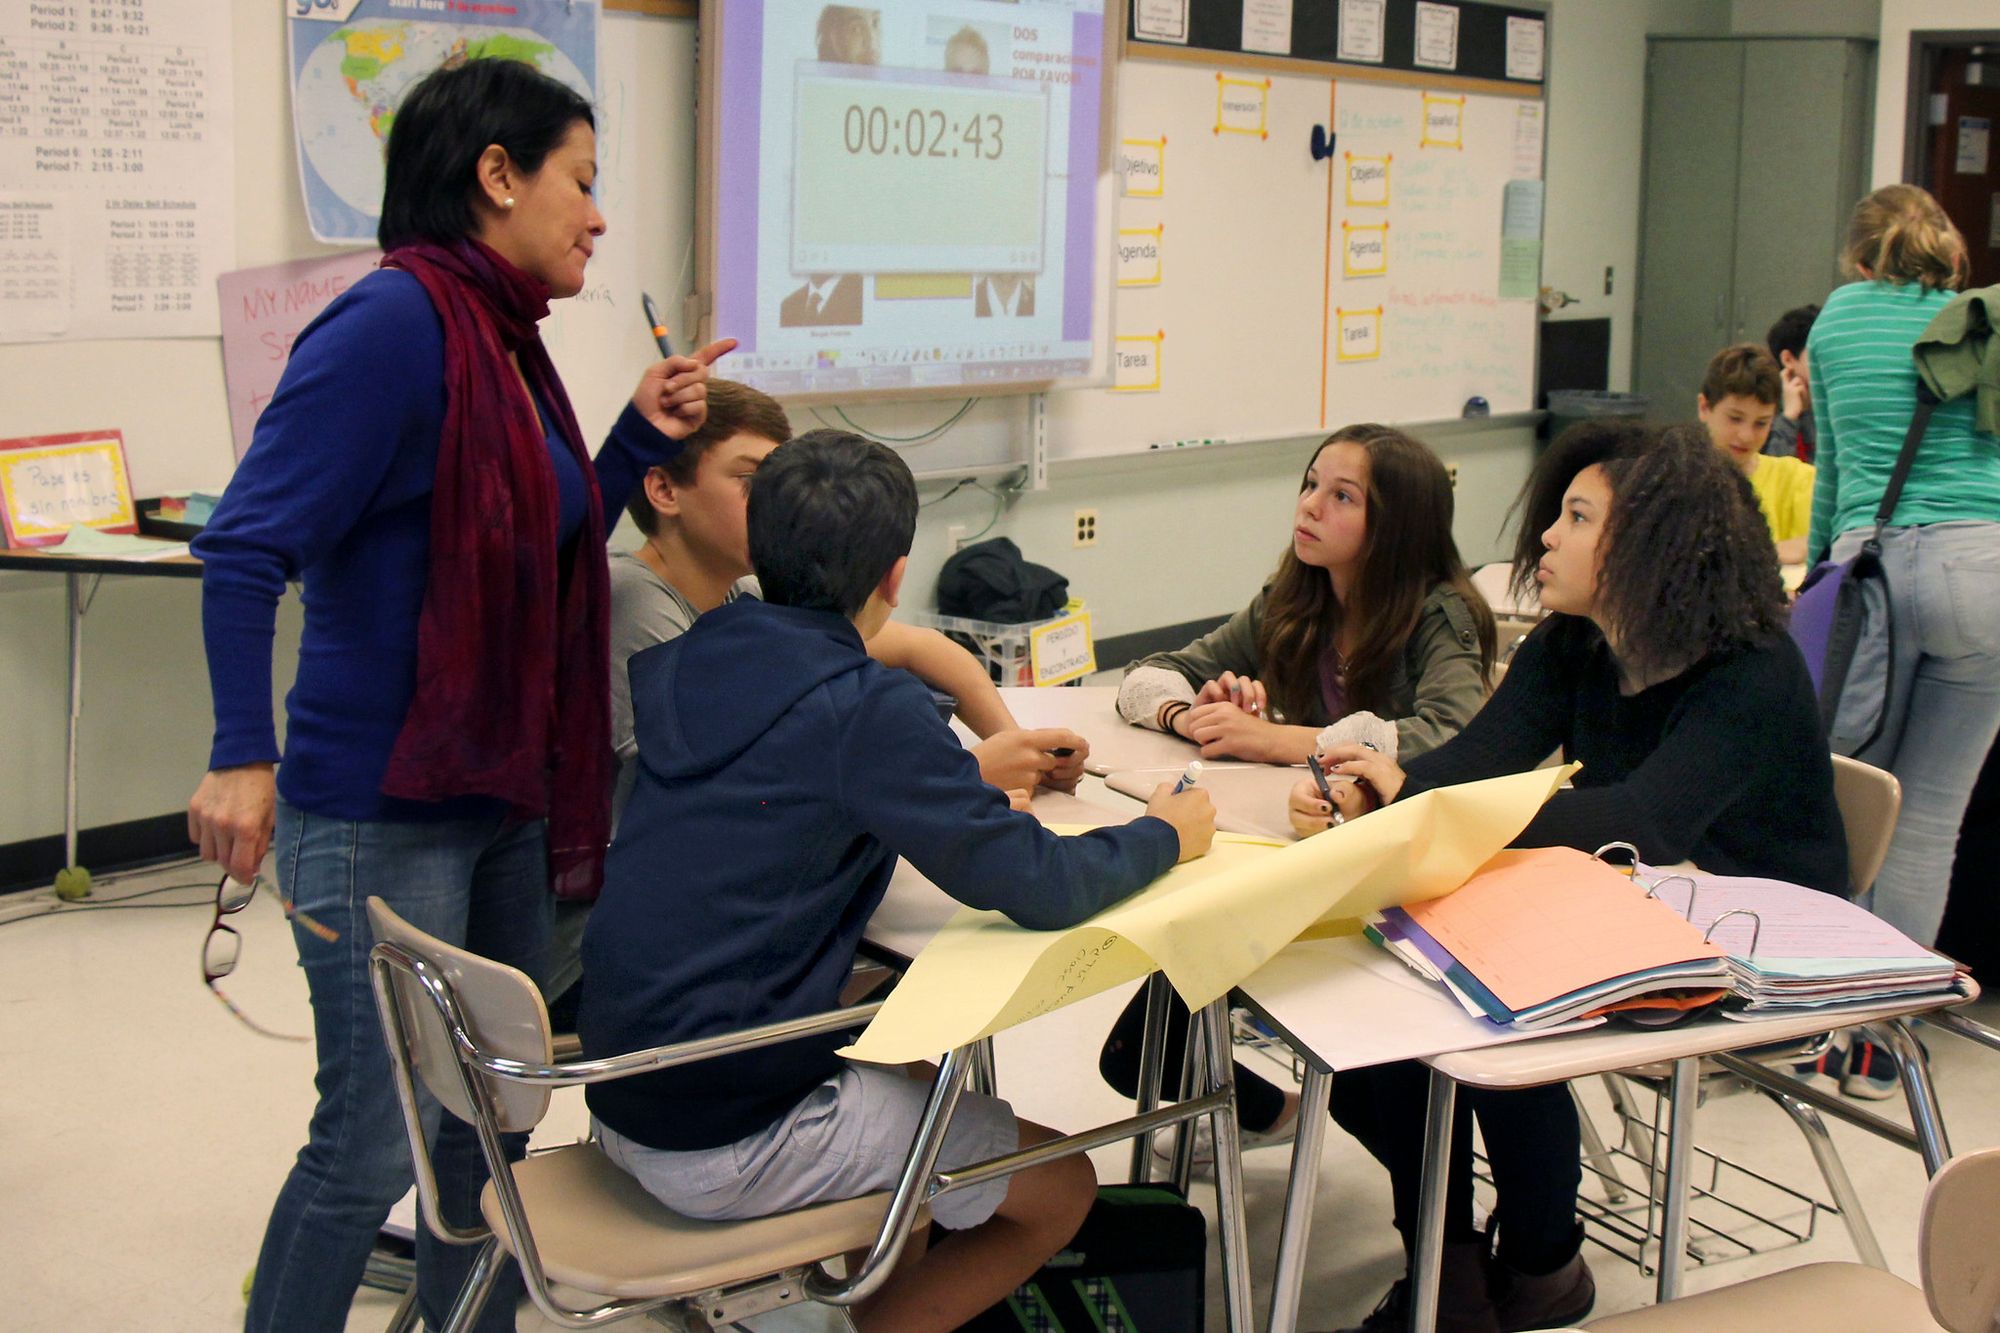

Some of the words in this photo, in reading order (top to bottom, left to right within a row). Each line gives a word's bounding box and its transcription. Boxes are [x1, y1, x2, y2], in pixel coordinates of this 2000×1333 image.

[30, 4, 64, 16] Period
[30, 18, 64, 30] Period
[1013, 26, 1039, 42] DOS
[1012, 67, 1036, 81] POR
[843, 104, 1004, 160] 00:02:43
[36, 146, 69, 158] Period
[121, 148, 142, 158] 2:11
[36, 161, 70, 172] Period
[243, 289, 276, 323] MY
